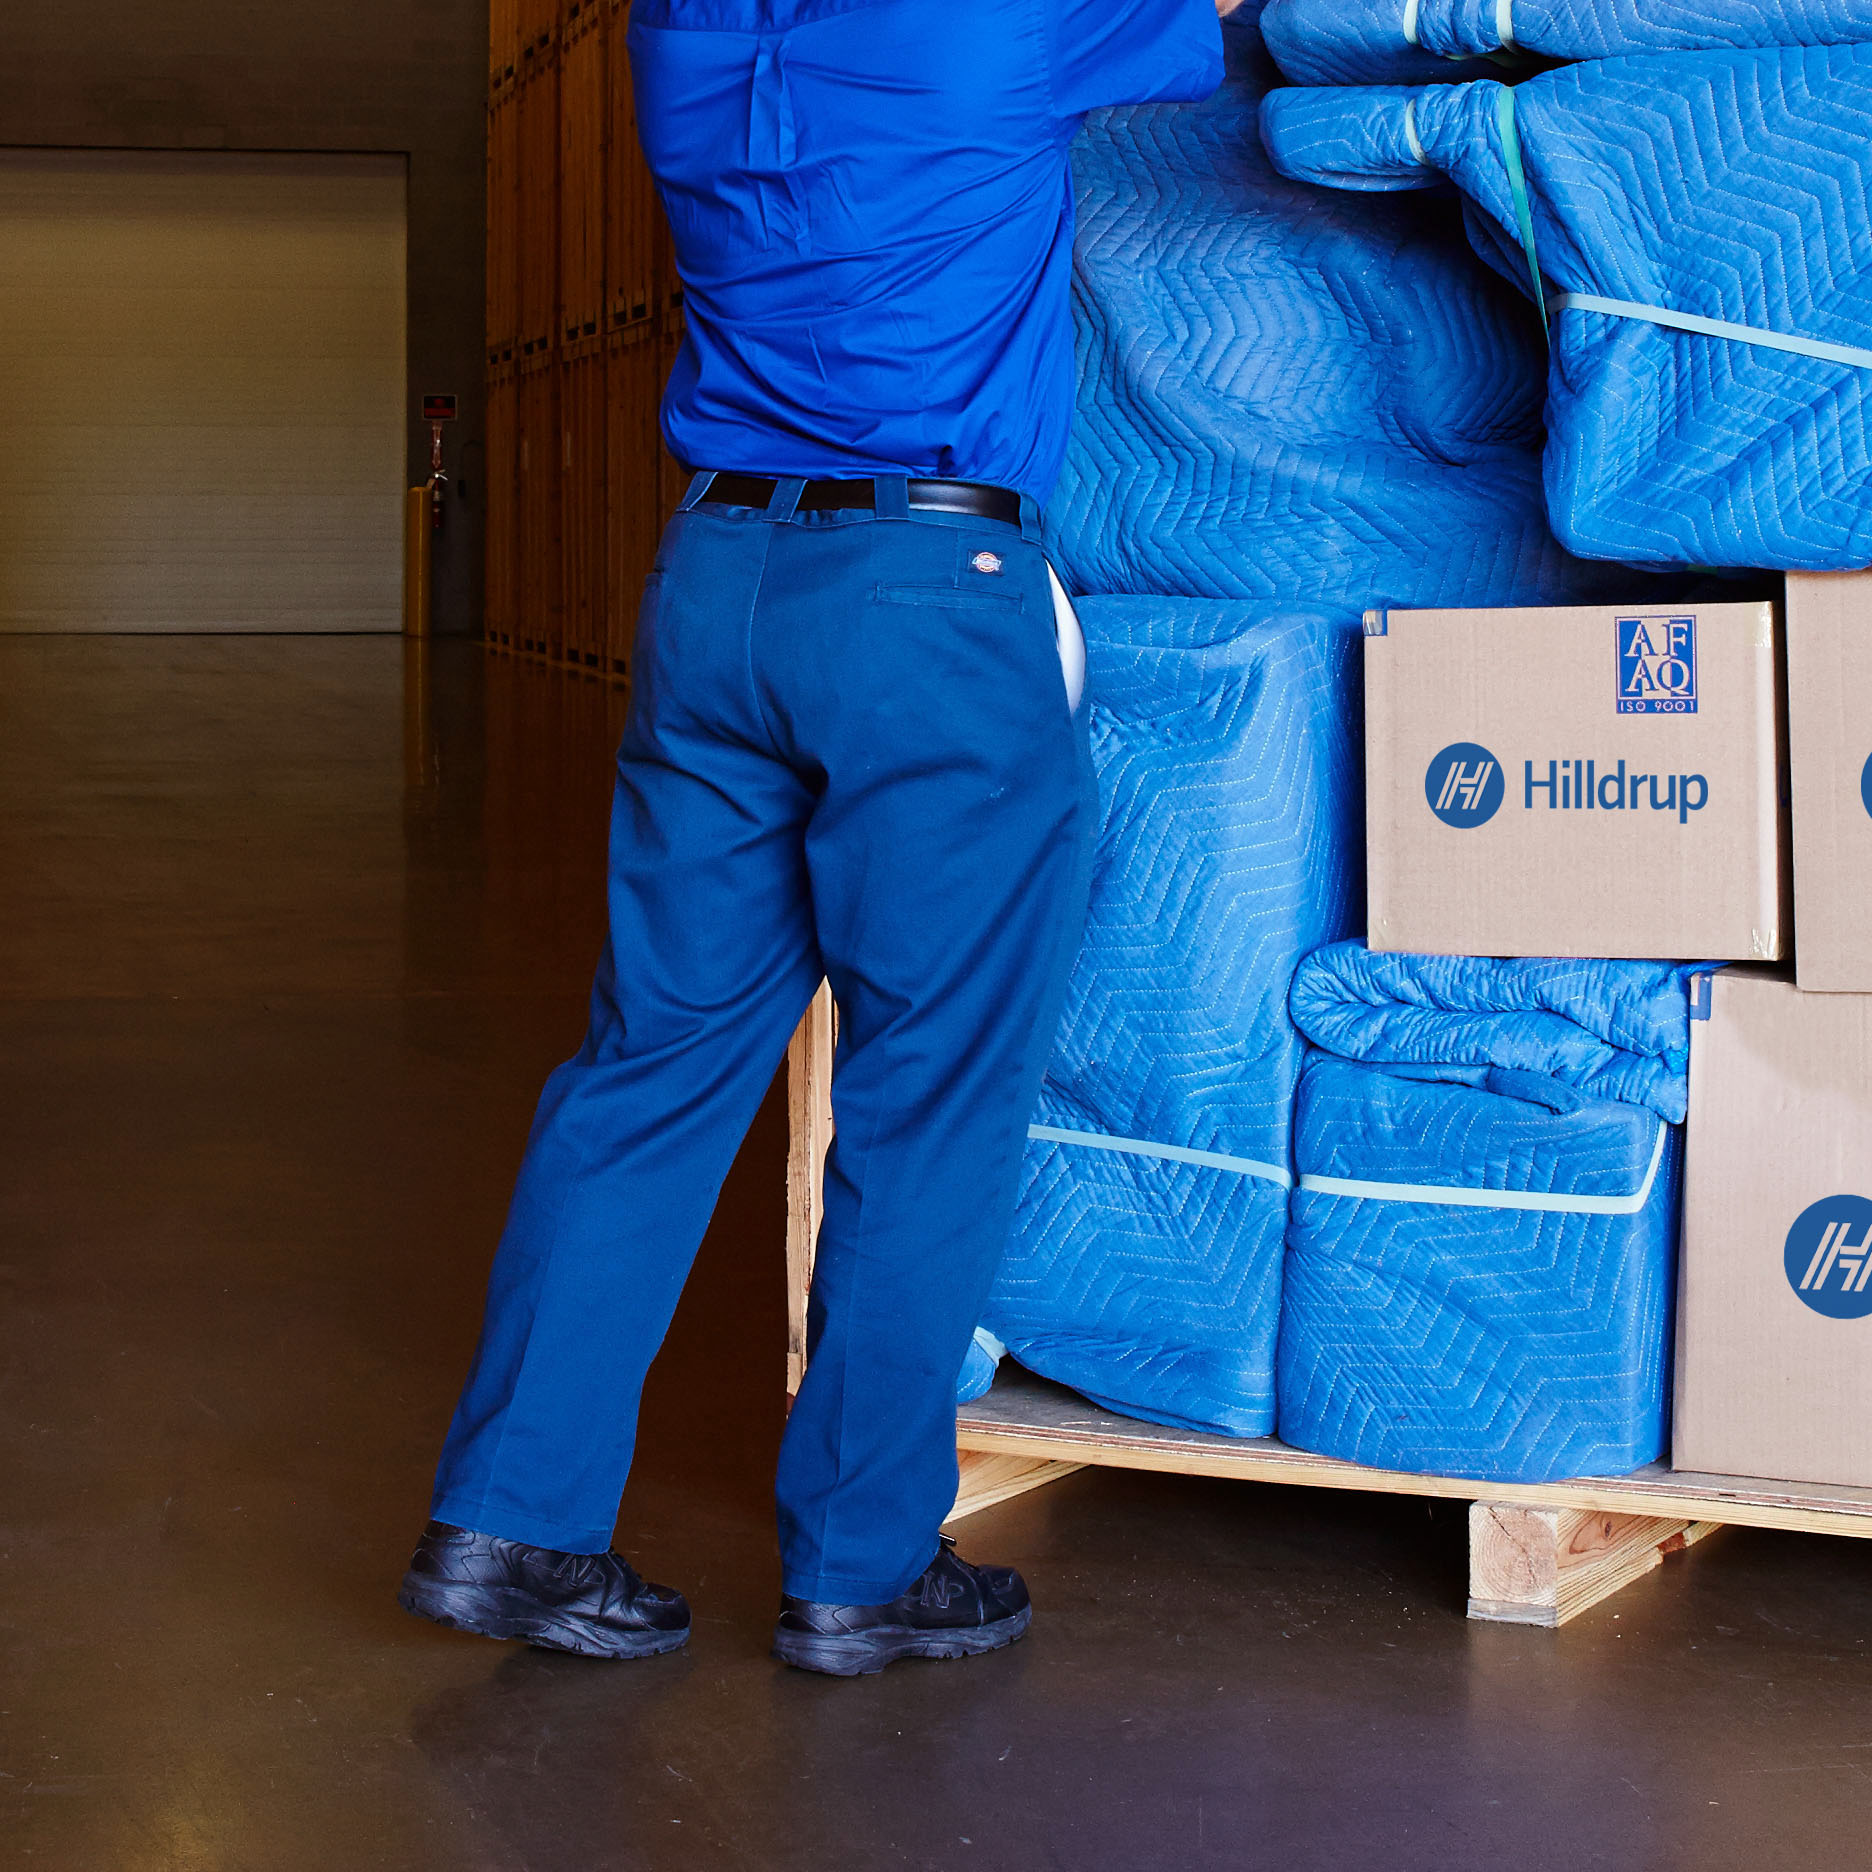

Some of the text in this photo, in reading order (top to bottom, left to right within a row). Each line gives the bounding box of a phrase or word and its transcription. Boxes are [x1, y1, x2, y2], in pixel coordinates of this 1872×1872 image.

[1620, 700, 1694, 712] ISO 9001
[1525, 760, 1708, 825] Hilldrup
